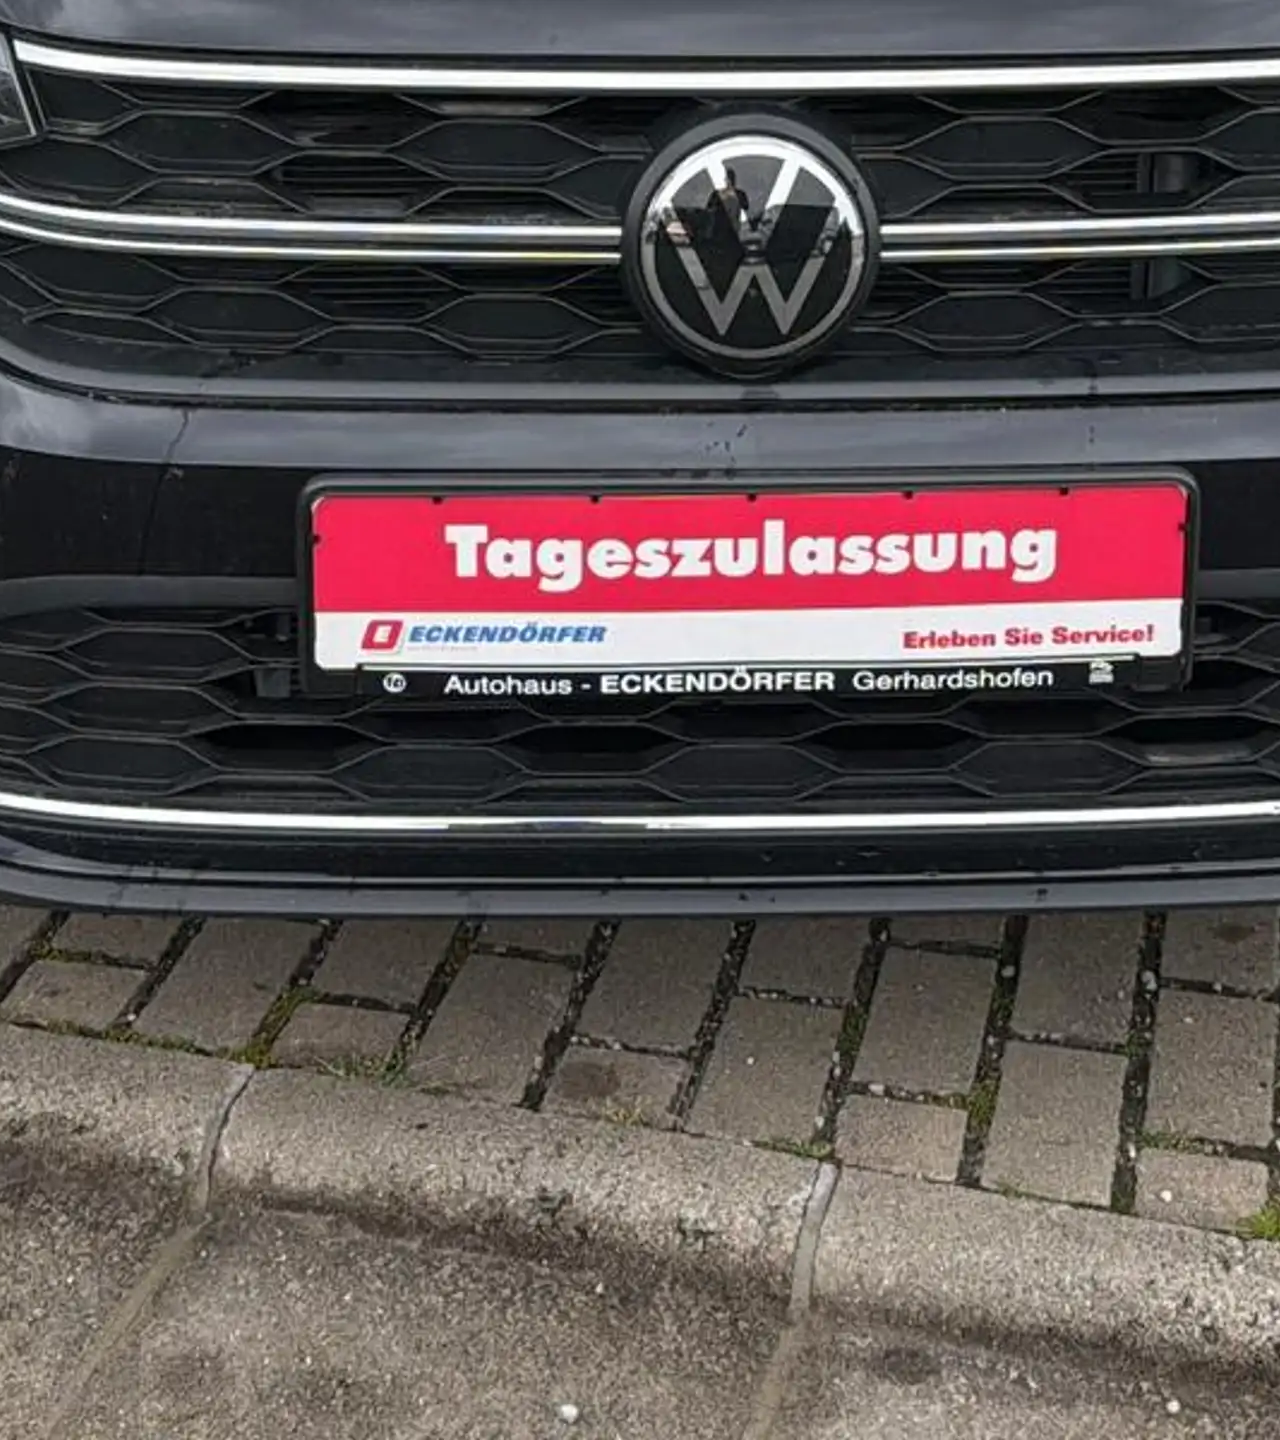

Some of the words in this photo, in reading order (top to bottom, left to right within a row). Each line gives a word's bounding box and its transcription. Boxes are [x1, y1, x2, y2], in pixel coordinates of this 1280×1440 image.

[444, 519, 1057, 591] Tageszulassung
[408, 622, 607, 644] ECKENDÖRFER
[902, 630, 997, 650] Erleben
[1004, 626, 1044, 647] Sie
[1051, 623, 1155, 645] Service!
[443, 674, 573, 696] Autohaus
[600, 665, 835, 694] ECKENDÖRFER
[852, 667, 1054, 691] Gerhardshofen
